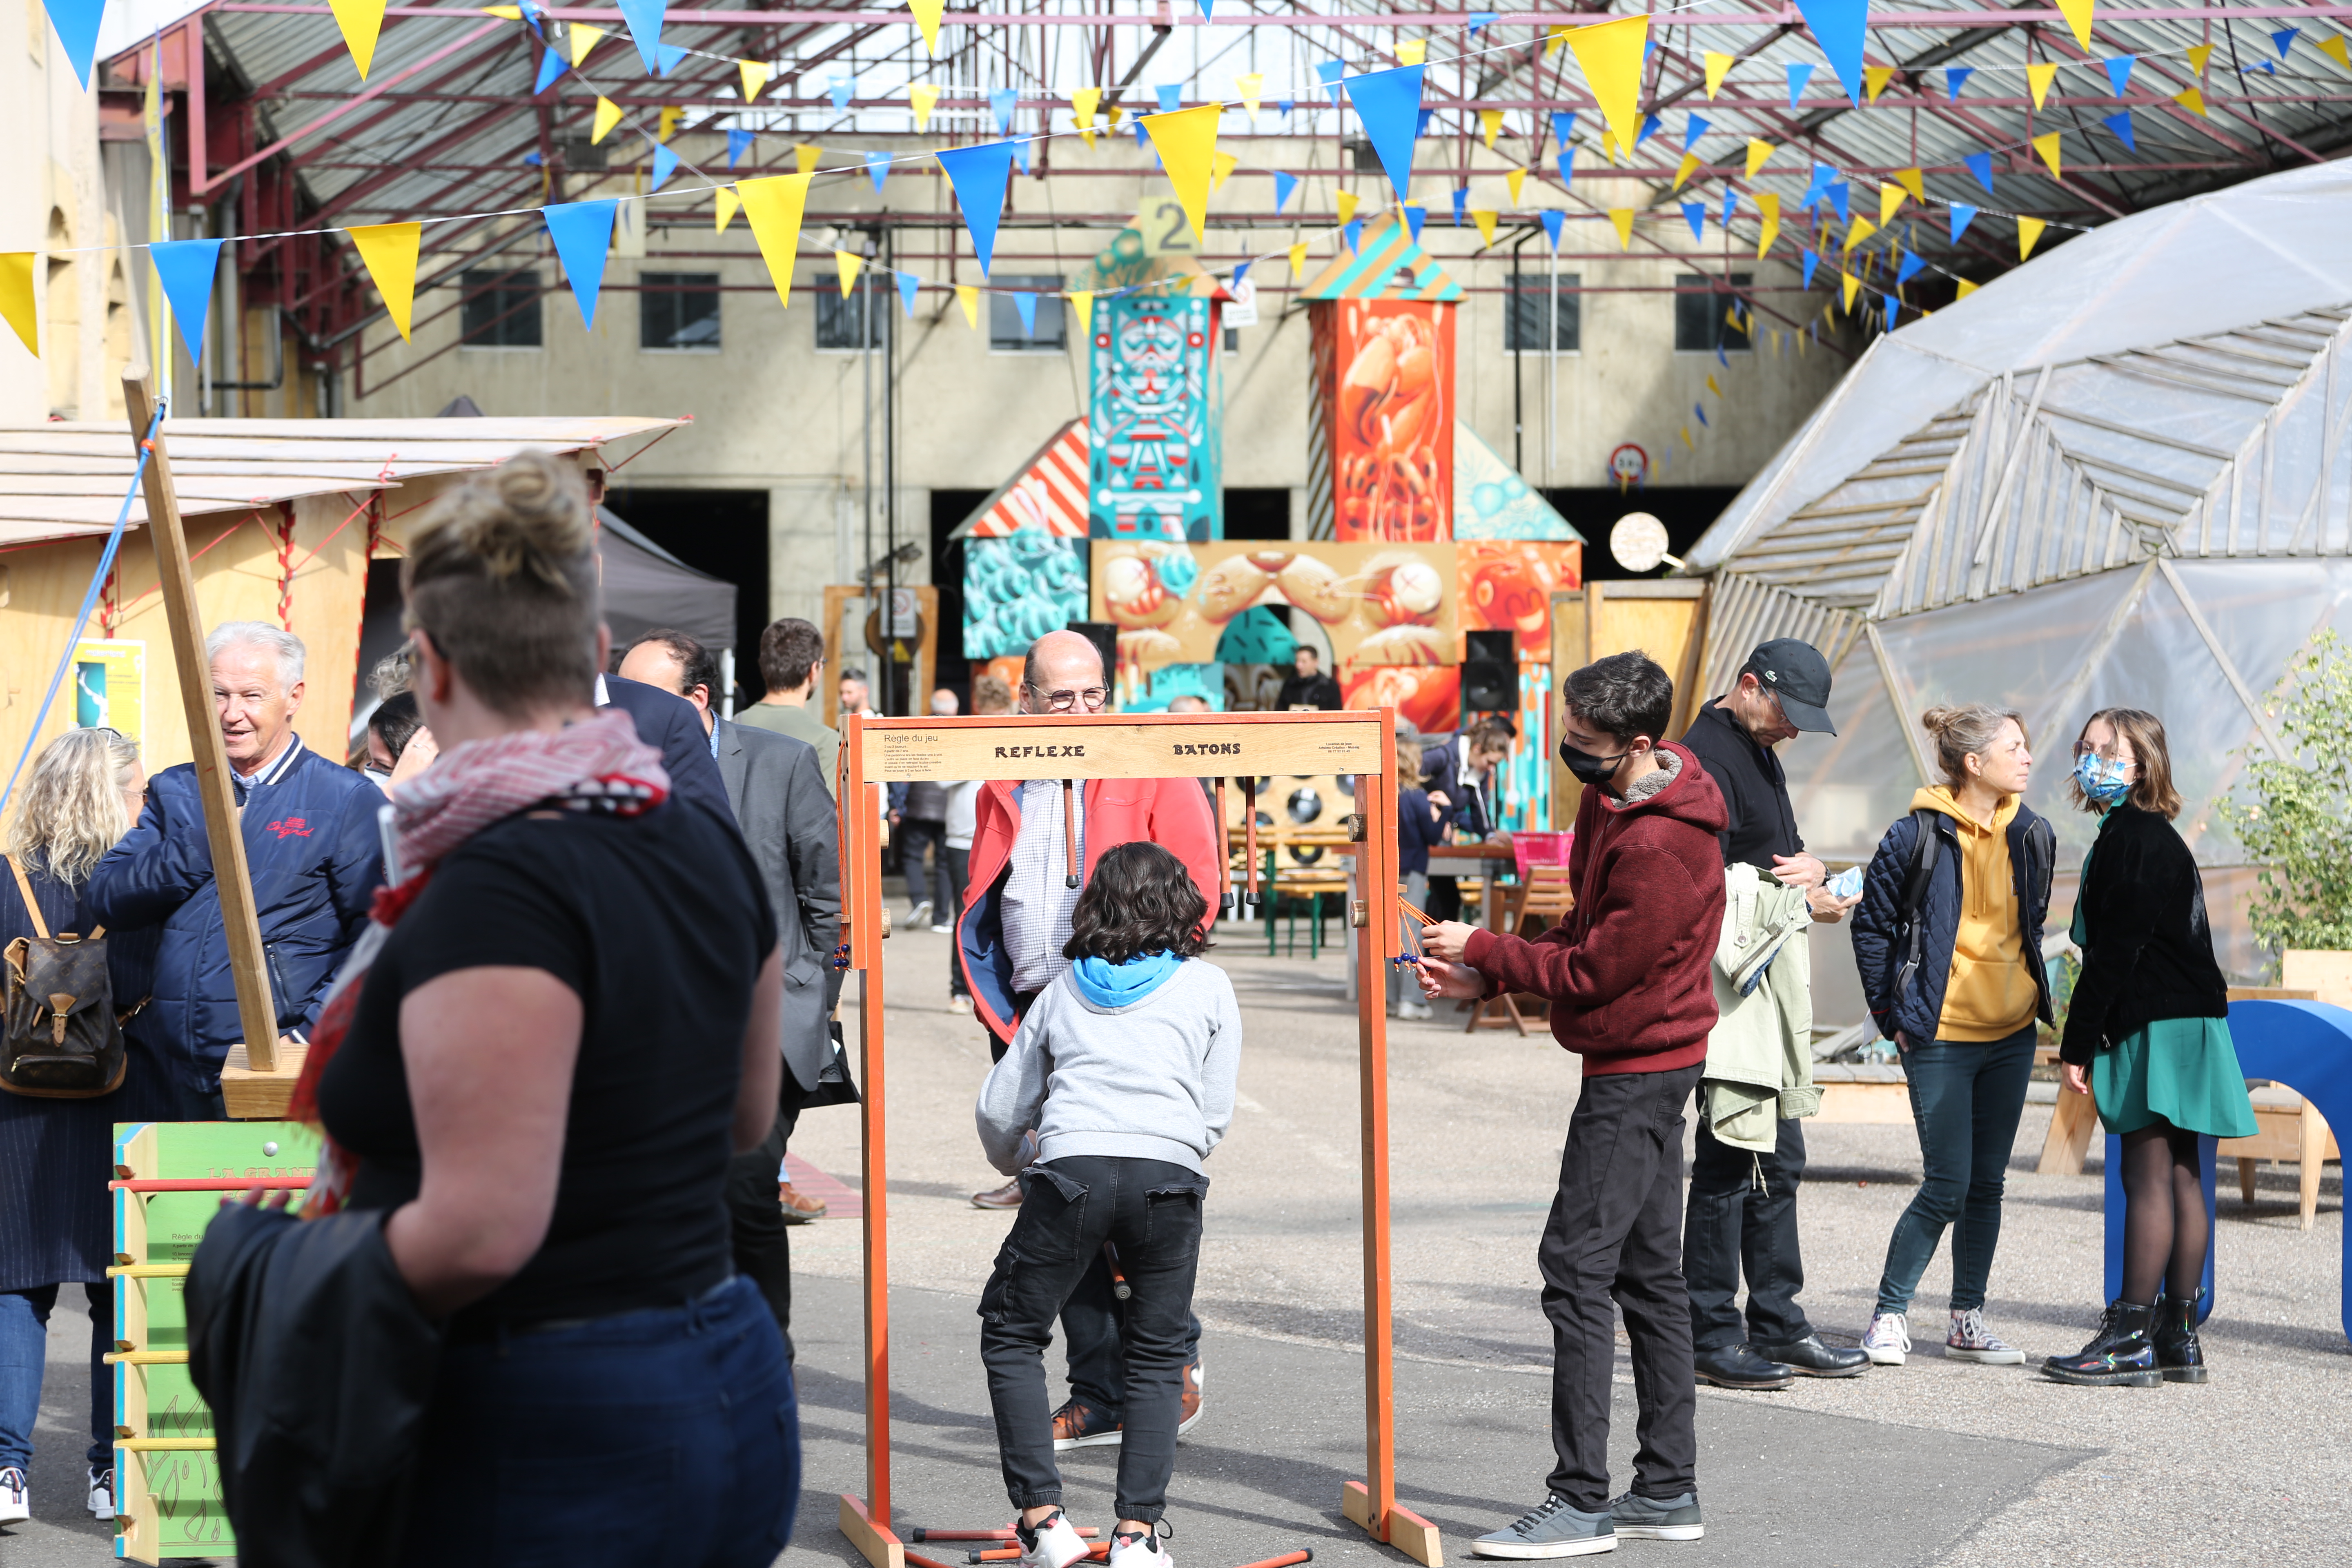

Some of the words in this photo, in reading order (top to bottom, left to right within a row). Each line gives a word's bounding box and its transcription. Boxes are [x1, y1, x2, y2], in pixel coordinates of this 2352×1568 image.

[1156, 203, 1191, 250] 2
[884, 734, 909, 744] Règle
[924, 734, 938, 744] jeu
[994, 745, 1085, 759] REFLEXE
[1173, 743, 1241, 756] BATONS
[206, 1167, 239, 1179] LA
[244, 1167, 318, 1178] GRAND
[172, 1233, 192, 1241] Règle
